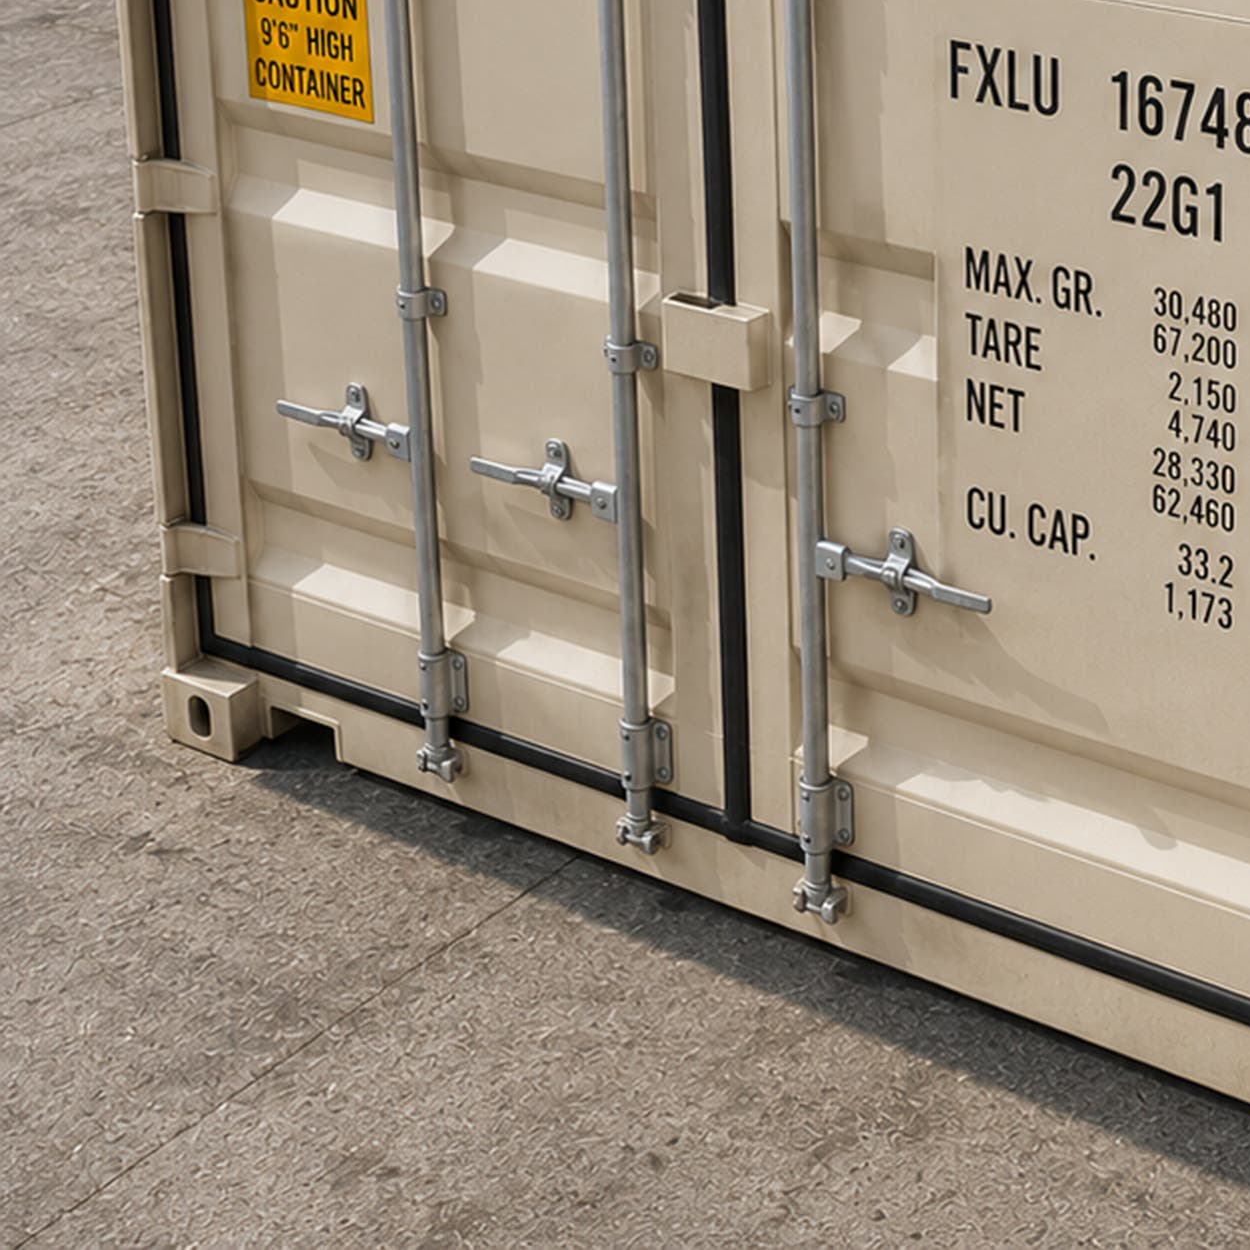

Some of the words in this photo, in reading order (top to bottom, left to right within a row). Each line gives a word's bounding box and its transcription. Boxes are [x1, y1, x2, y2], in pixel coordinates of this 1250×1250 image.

[306, 26, 353, 62] HIGH
[255, 57, 366, 109] CONTAINER
[950, 39, 1060, 116] FXLU
[1111, 163, 1223, 243] 22G1
[965, 246, 1042, 304] MAX.
[1052, 265, 1102, 317] GR.
[1154, 287, 1237, 332] 30,480
[965, 312, 1042, 372] TARE
[1153, 323, 1237, 370] 67,200
[966, 378, 1026, 433] NET
[1168, 371, 1237, 414] 2,150
[1167, 409, 1236, 452] 4,740
[1152, 447, 1235, 495] 28,330
[1152, 483, 1235, 533] 62,460
[967, 487, 1016, 539] CU.
[1028, 503, 1096, 561] CAP.
[1177, 543, 1234, 589] 33.2
[1165, 582, 1233, 630] 1,173
